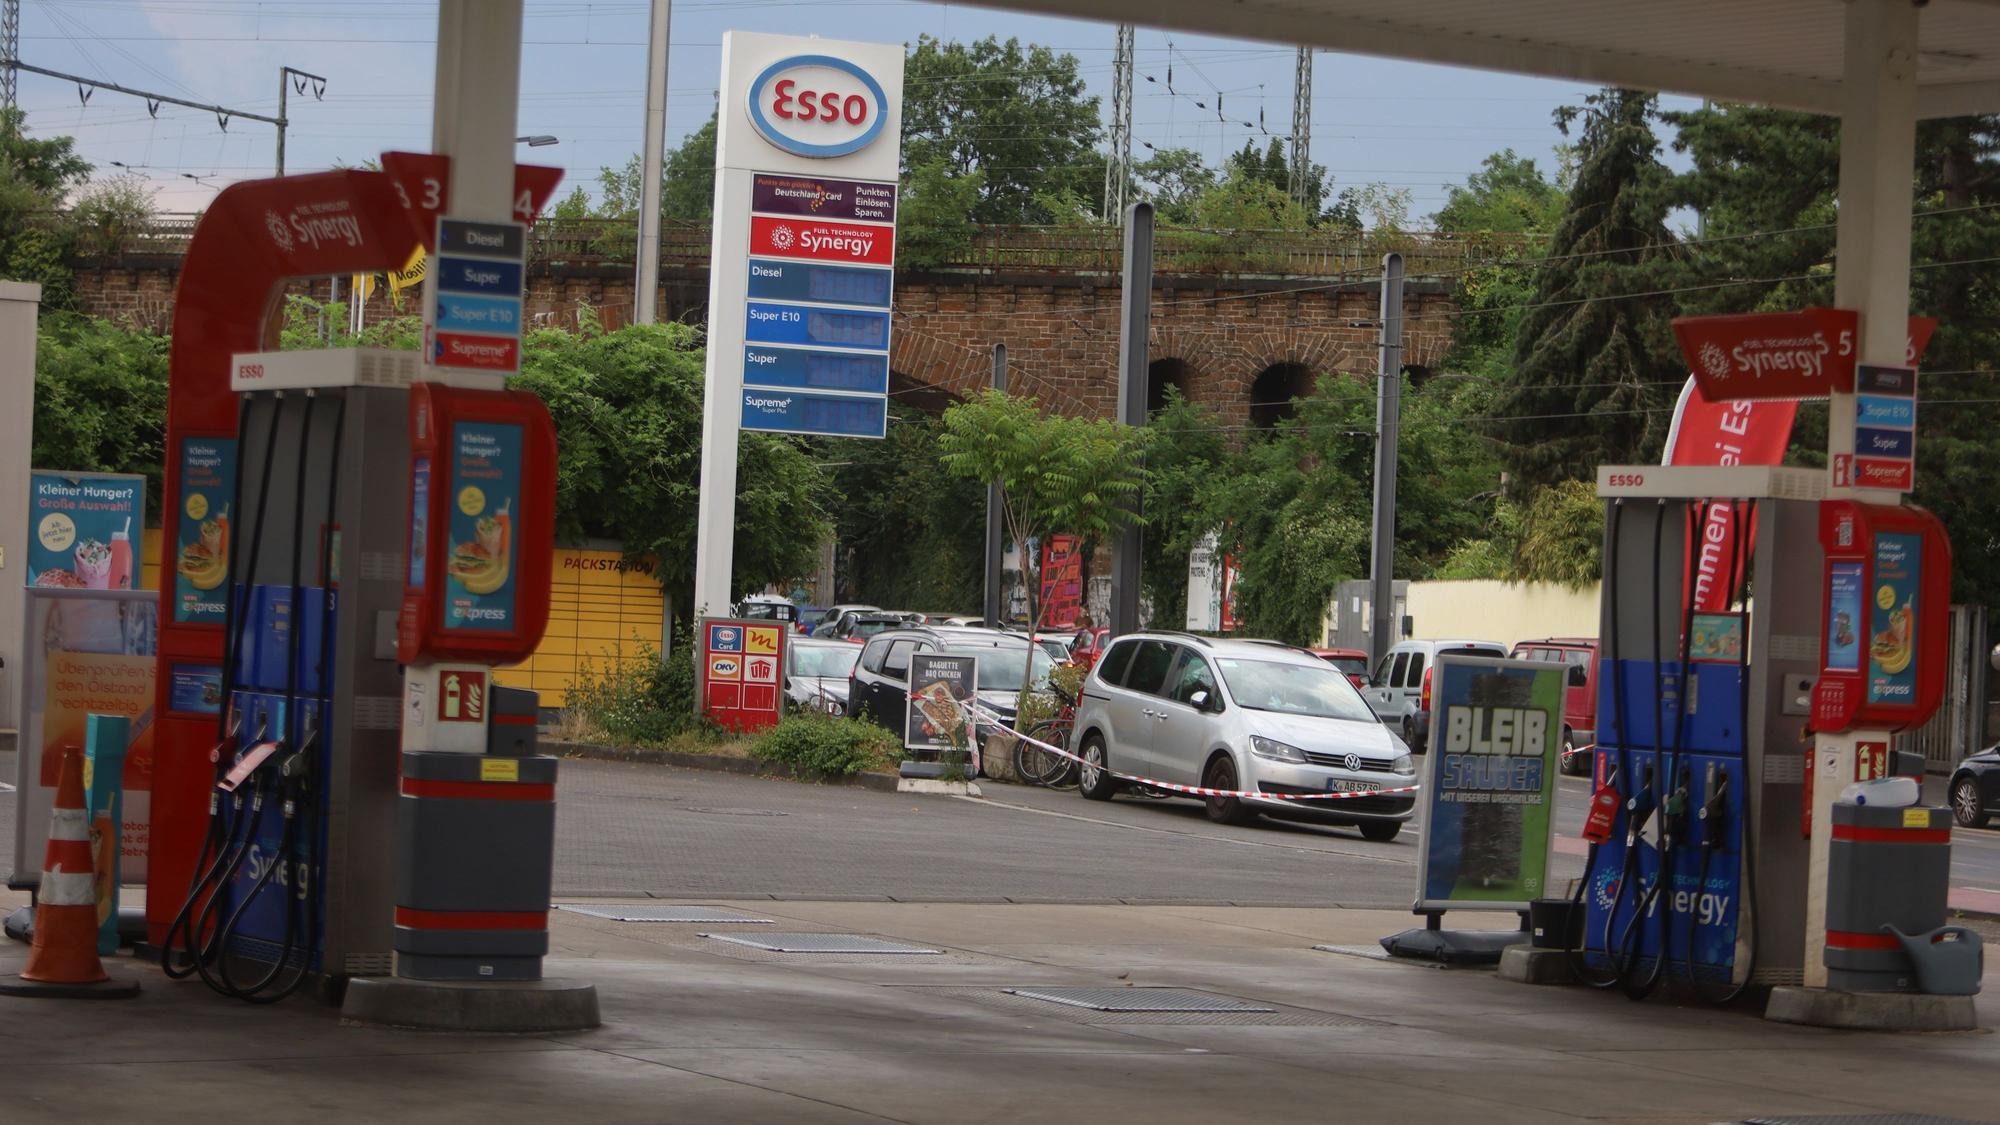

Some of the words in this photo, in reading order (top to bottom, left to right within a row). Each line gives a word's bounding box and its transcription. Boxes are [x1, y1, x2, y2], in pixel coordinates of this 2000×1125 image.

[421, 178, 441, 209] 3
[775, 187, 820, 199] Deutschland
[825, 192, 842, 201] Card
[856, 186, 891, 197] Punkten.
[514, 189, 534, 218] 4
[855, 197, 891, 208] Einlösen.
[855, 208, 885, 218] Sparen.
[290, 213, 363, 250] Synergy
[831, 229, 873, 238] TECHNOLOGY
[466, 231, 504, 248] Diesel
[800, 231, 873, 256] Synergy
[464, 268, 501, 287] Super
[752, 266, 782, 278] Diesel
[451, 305, 488, 324] Super
[490, 307, 513, 323] E10
[750, 310, 779, 323] Super
[782, 312, 800, 322] E10
[1813, 332, 1829, 355] 5
[1838, 330, 1852, 356] 5
[748, 352, 777, 365] Super
[1732, 346, 1823, 378] Synergy
[1872, 436, 1898, 450] Super
[1609, 474, 1644, 487] ESSO
[39, 483, 82, 496] Kleiner
[84, 487, 134, 500] Hunger?
[183, 602, 227, 614] express
[453, 608, 507, 622] express
[715, 663, 736, 671] DKV
[928, 660, 959, 670] BAGUETTE
[937, 670, 962, 679] CHICKEN
[56, 679, 84, 693] den
[55, 698, 139, 715] rechtzeitig
[1445, 705, 1547, 756] BLEIB
[1442, 754, 1544, 792] SAUBER
[1440, 791, 1455, 802] MIT
[1672, 874, 1731, 889] TECHNLOGY
